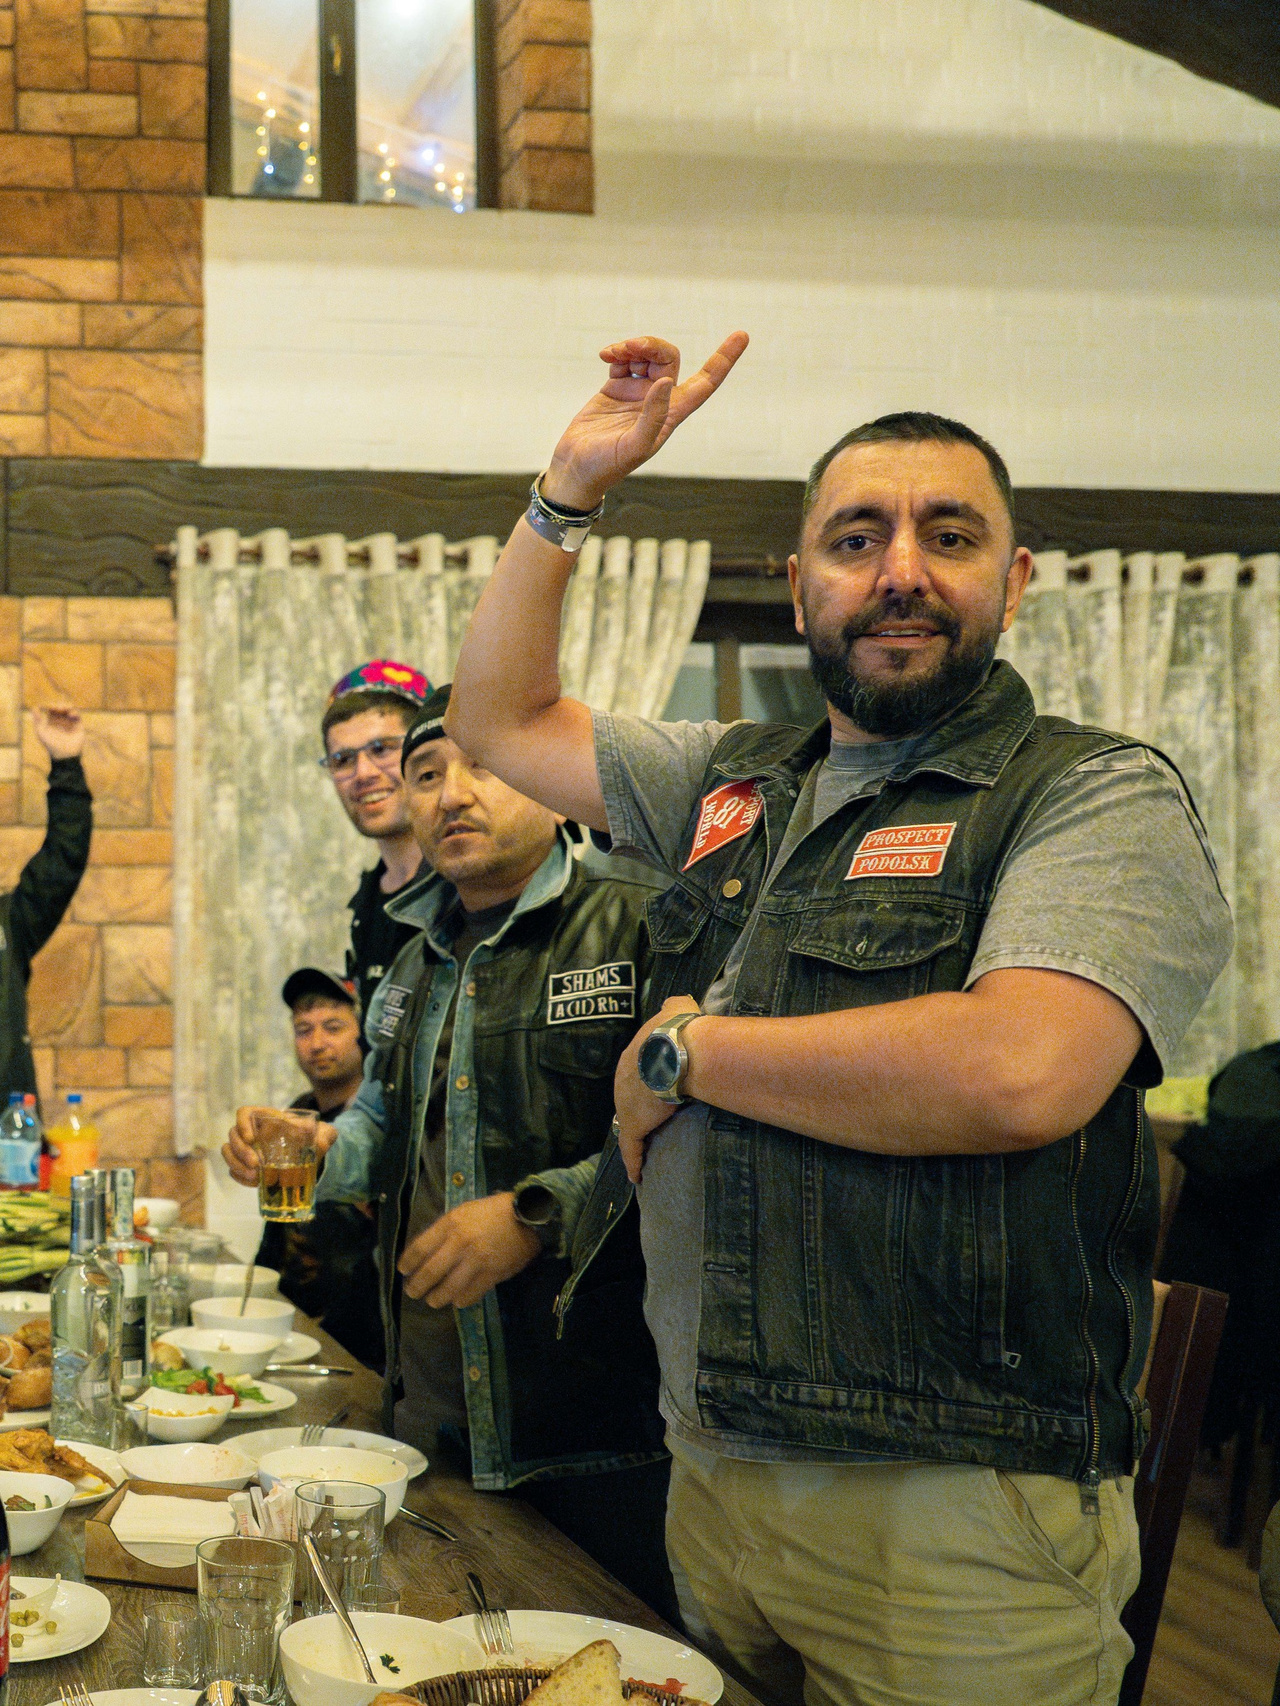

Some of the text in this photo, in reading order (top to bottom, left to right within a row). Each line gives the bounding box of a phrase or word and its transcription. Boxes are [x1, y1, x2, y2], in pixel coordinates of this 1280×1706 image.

[696, 800, 718, 849] WORLD
[863, 828, 949, 849] PROSPECT
[856, 854, 933, 873] PODOLSK
[561, 966, 622, 994] SHAMS
